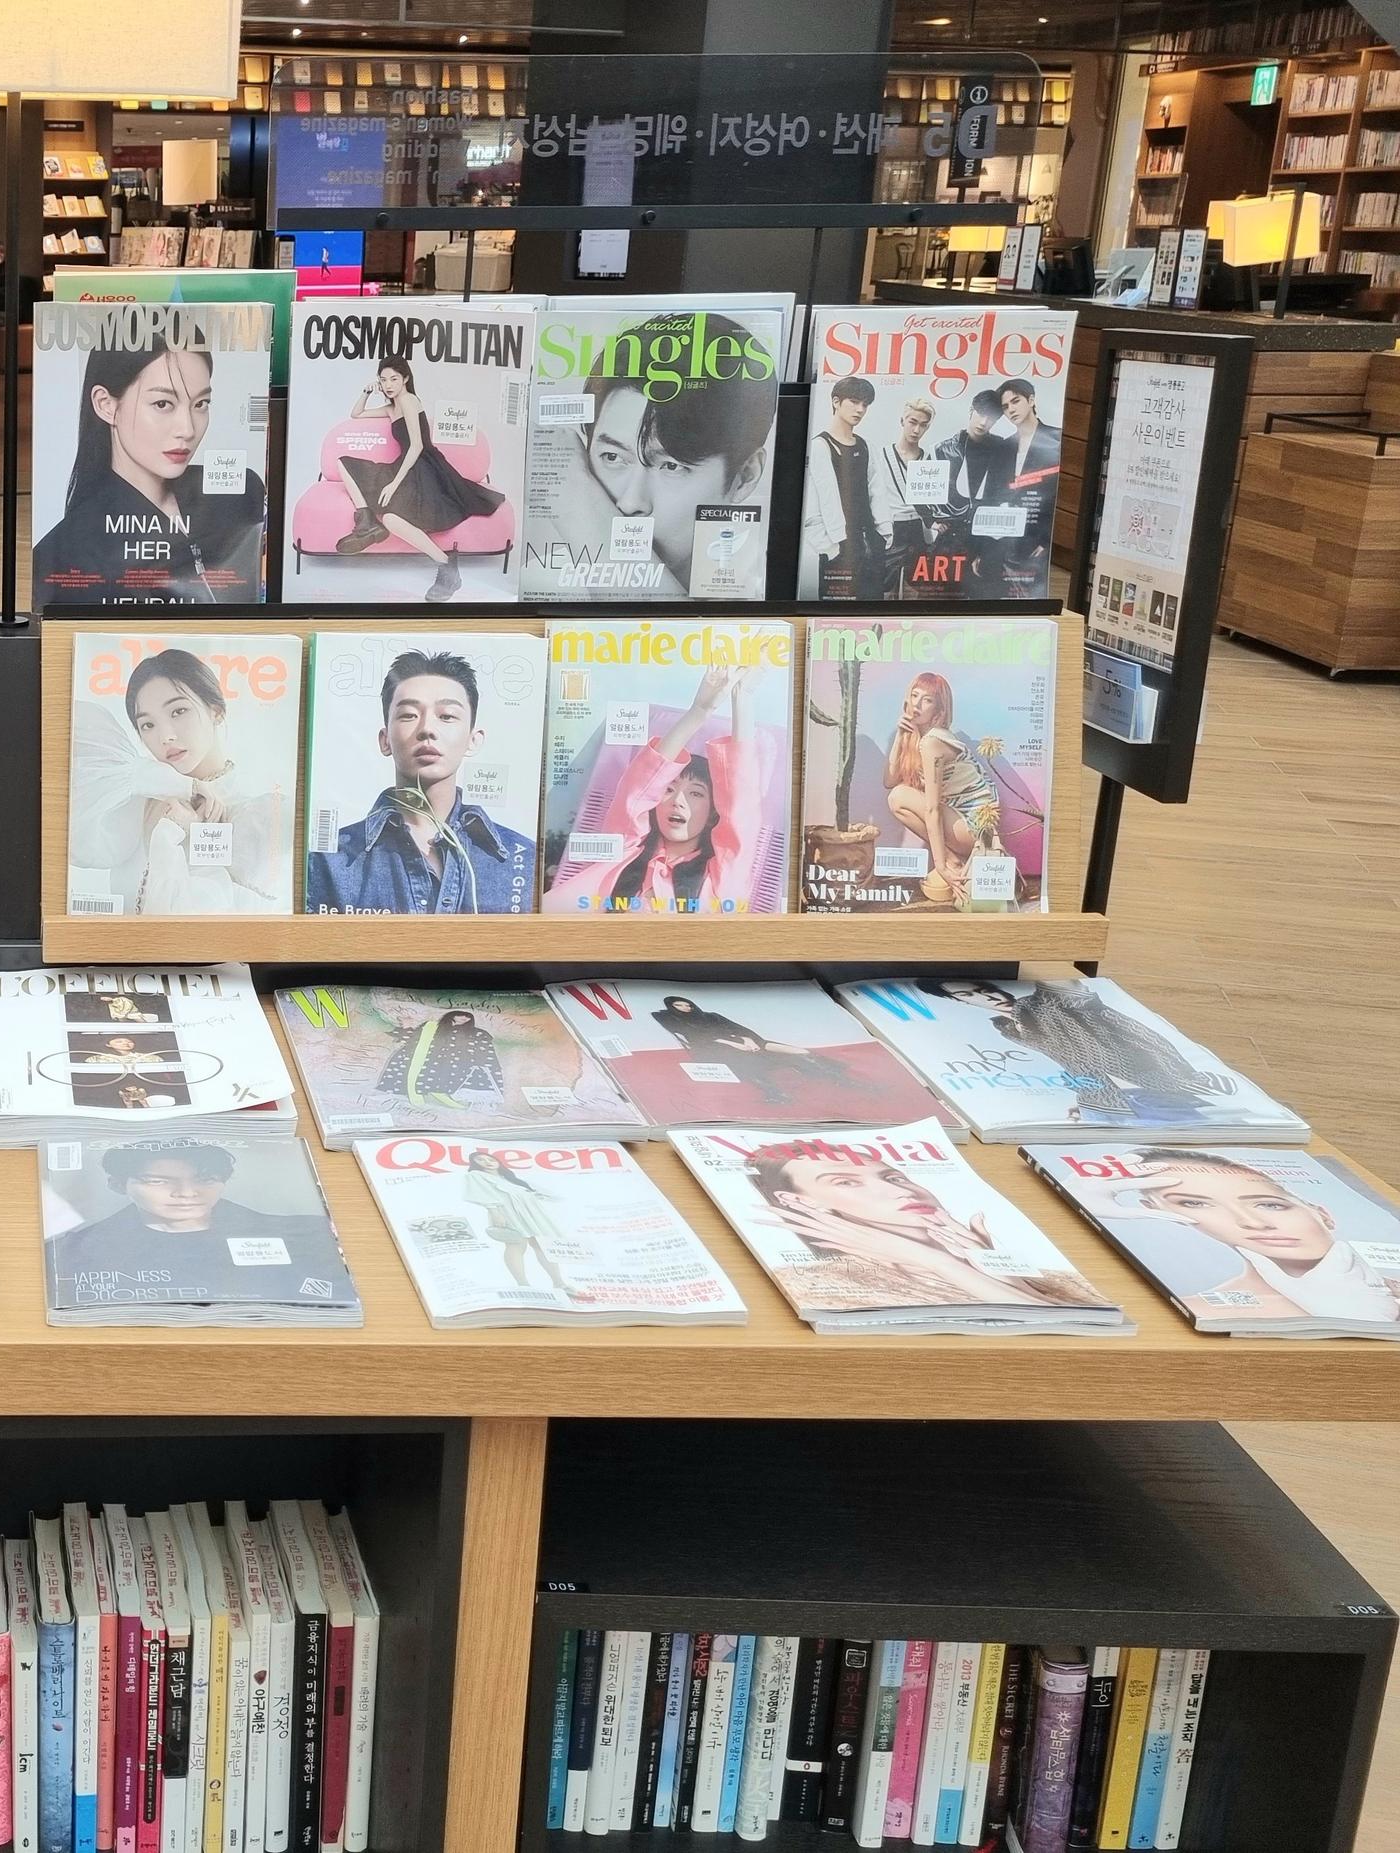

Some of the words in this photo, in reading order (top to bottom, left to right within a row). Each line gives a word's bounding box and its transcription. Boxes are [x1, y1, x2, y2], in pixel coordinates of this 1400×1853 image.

[35, 303, 271, 352] COSMOPOLITAN
[903, 314, 929, 332] Get
[930, 313, 983, 331] excited
[303, 314, 524, 369] COSMOPOLITAN
[537, 312, 776, 404] Singles
[822, 312, 1065, 400] Singles
[1139, 397, 1186, 421] 고객감사
[1131, 422, 1186, 449] 사은이벤트
[105, 514, 162, 534] MINA
[169, 513, 191, 534] IN
[700, 509, 732, 519] SPECIAL
[731, 511, 757, 523] GIFT
[123, 541, 171, 560] HER
[525, 541, 604, 570] NEW
[557, 562, 665, 588] GREENISM
[912, 555, 968, 582] ART
[551, 623, 677, 667] marie
[680, 624, 791, 668] claire
[811, 621, 938, 664] marie
[942, 623, 1051, 665] claire
[807, 863, 861, 882] Dear
[577, 896, 642, 912] STAND
[650, 897, 700, 912] WITH
[807, 883, 848, 904] My
[851, 885, 914, 907] Family
[318, 903, 339, 914] Be
[345, 904, 392, 915] Brave
[289, 986, 351, 1029] W
[563, 982, 633, 1021] W
[857, 983, 937, 1021] W
[945, 1061, 1008, 1078] my
[374, 1138, 624, 1174] Queen
[55, 1269, 173, 1286] HAPPINESS
[90, 1283, 116, 1292] YOUR
[75, 1287, 209, 1304] DOORSTEP
[307, 1620, 318, 1676] 금융지식이
[126, 1657, 136, 1684] 디테일의
[170, 1652, 185, 1698] 채근담
[960, 1659, 973, 1680] 2013
[1009, 1663, 1019, 1681] THE
[305, 1682, 316, 1715] 미래의
[956, 1683, 970, 1707] 부동산
[1004, 1683, 1016, 1719] SECRET
[1091, 1680, 1112, 1708] 듀이
[233, 1698, 245, 1726] 아내는
[252, 1689, 265, 1734] 야구예찬
[272, 1693, 290, 1739] 경청
[304, 1718, 315, 1738] 부를
[20, 1753, 33, 1773] 1cm
[191, 1734, 204, 1770] 시크릿
[303, 1742, 314, 1784] 결정한다
[1000, 1745, 1010, 1775] RHONDA
[997, 1776, 1005, 1797] BYRNE
